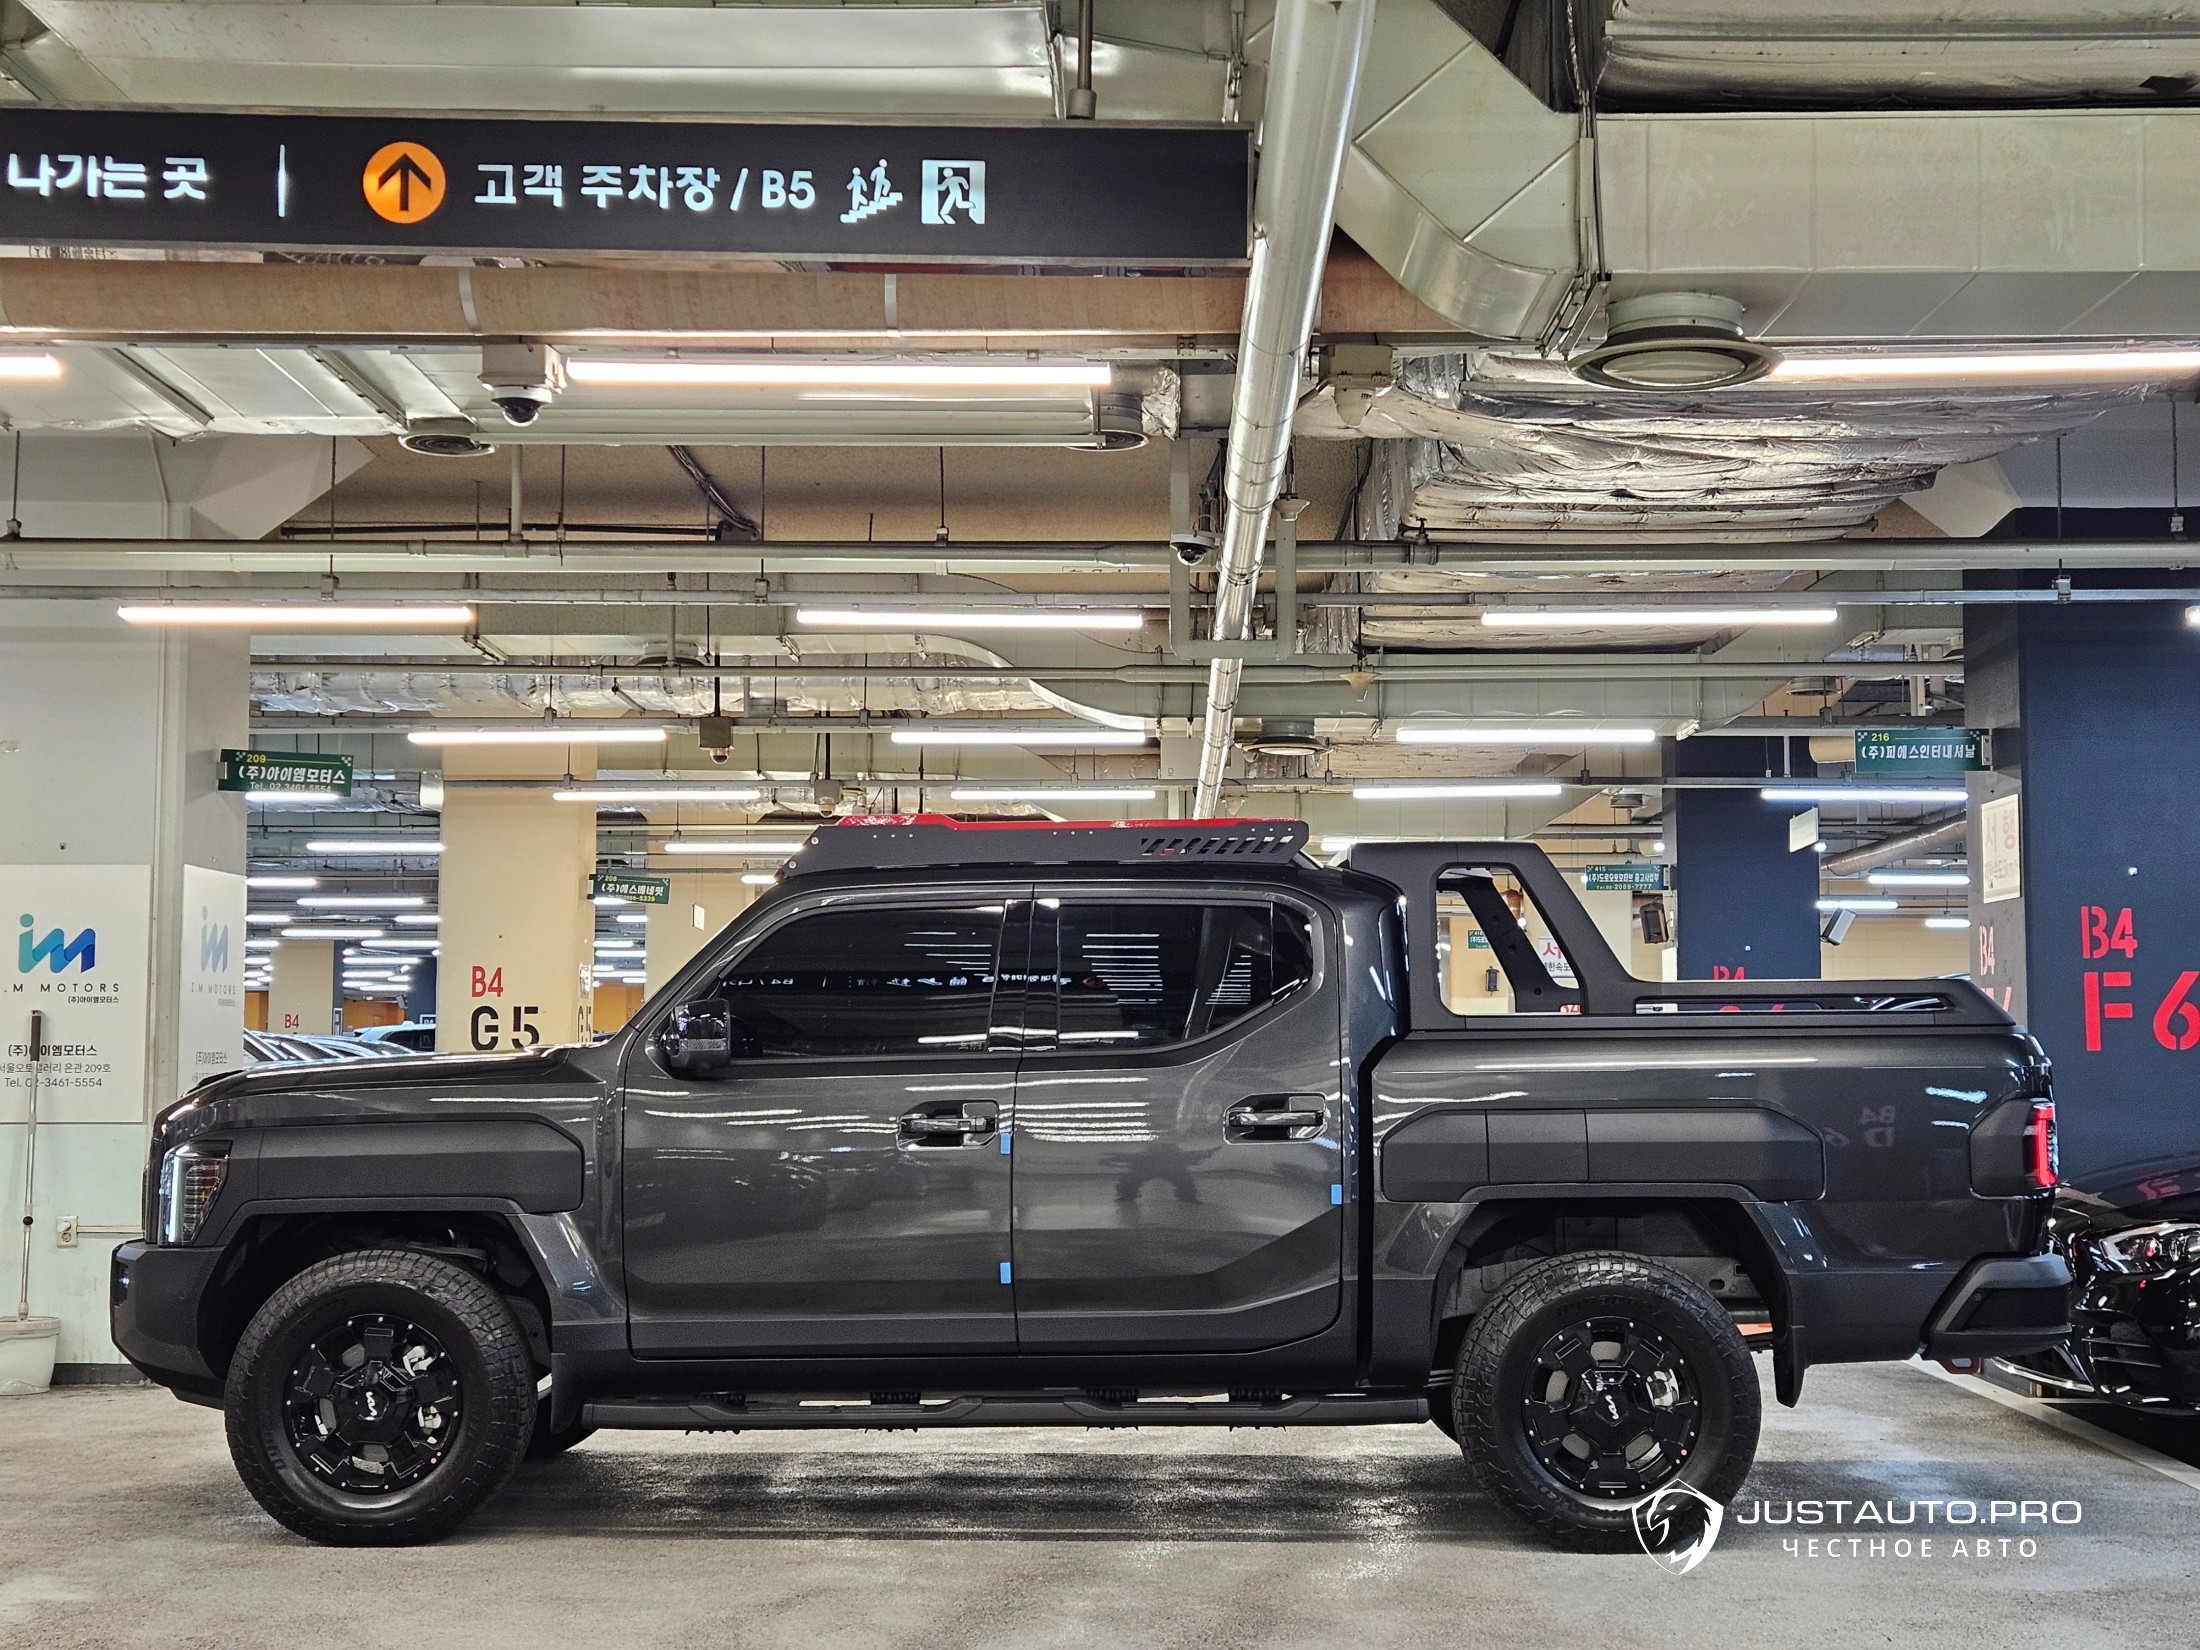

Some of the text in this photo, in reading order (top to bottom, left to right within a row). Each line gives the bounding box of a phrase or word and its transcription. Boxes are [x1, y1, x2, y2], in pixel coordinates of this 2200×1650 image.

[7, 152, 210, 201] 나가는 곳
[474, 163, 563, 208] 고객
[580, 164, 721, 212] 주차장
[760, 168, 816, 210] B5
[1871, 732, 1890, 742] 216
[246, 754, 267, 764] 209
[238, 765, 346, 785] (주)아이엠모터스
[2080, 905, 2138, 959] B4
[1979, 925, 1996, 976] B4
[40, 983, 119, 993] MOTORS
[471, 965, 504, 998] B4
[208, 984, 236, 995] MOTORS
[284, 1014, 299, 1028] B4
[8, 1045, 98, 1057] (주)이엠모터스
[84, 1063, 112, 1073] 209호
[4, 1078, 22, 1088] Tel.
